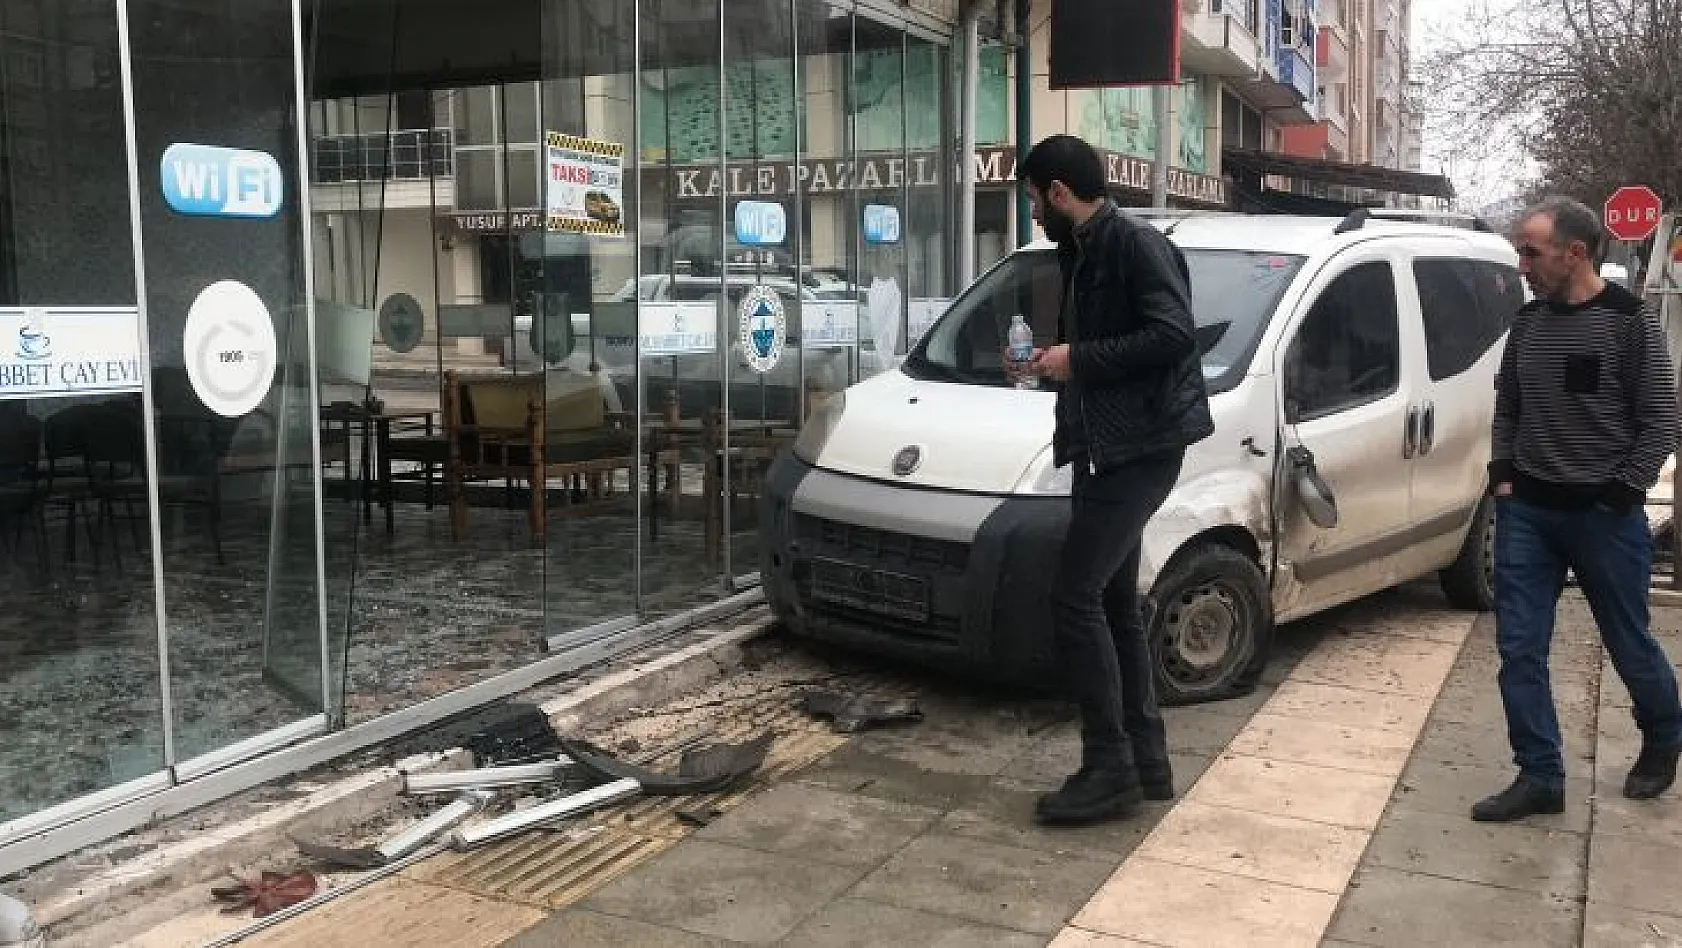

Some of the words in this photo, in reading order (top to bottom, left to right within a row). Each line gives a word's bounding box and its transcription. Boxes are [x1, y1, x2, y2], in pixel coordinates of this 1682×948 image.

[676, 166, 776, 198] KALE
[787, 151, 1018, 193] PAZARLM
[1106, 153, 1150, 190] KALE
[1608, 207, 1656, 224] DUR
[59, 361, 99, 390] ÇAY
